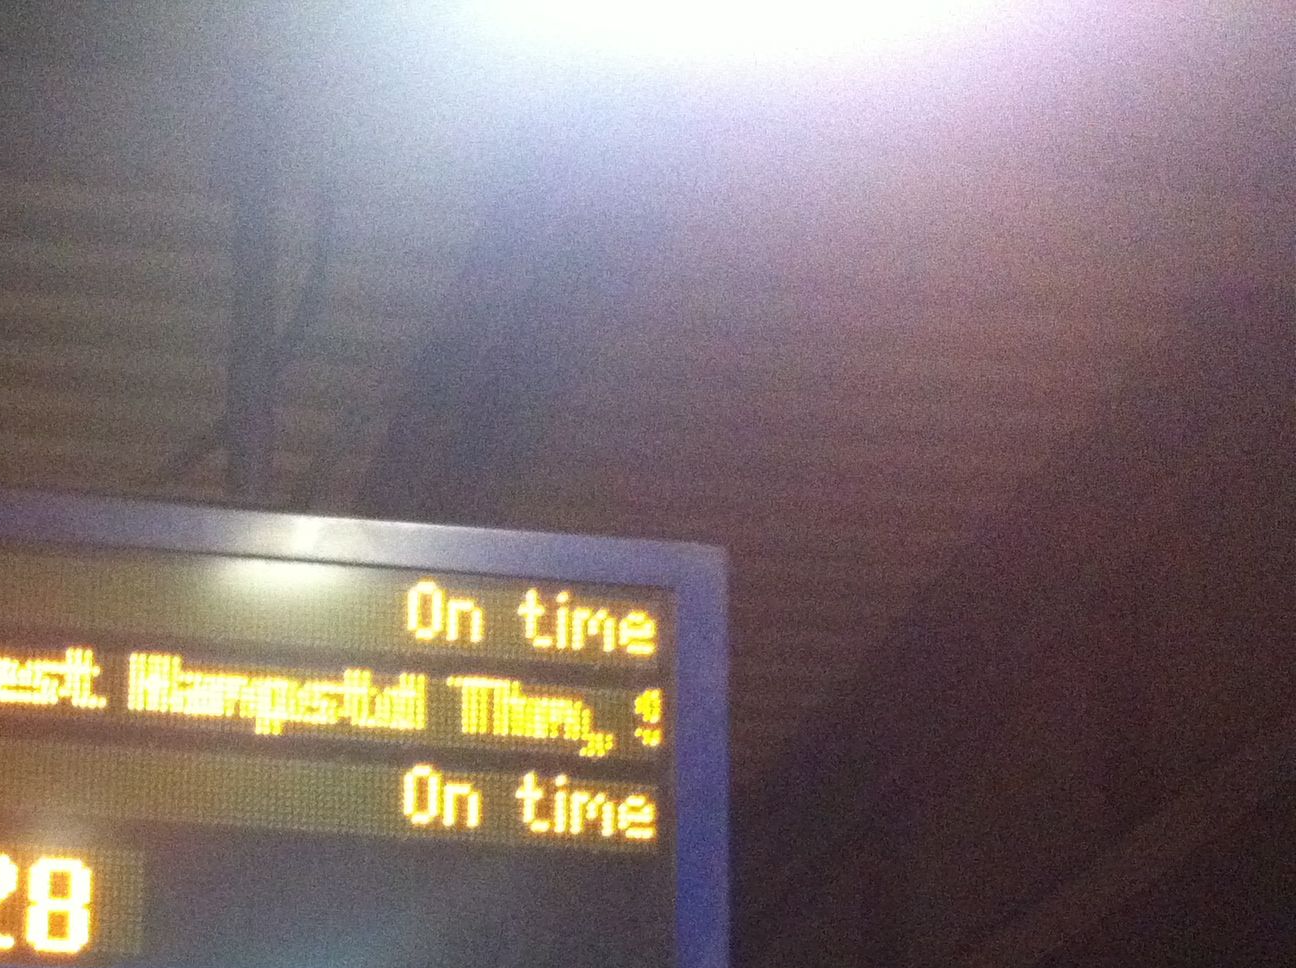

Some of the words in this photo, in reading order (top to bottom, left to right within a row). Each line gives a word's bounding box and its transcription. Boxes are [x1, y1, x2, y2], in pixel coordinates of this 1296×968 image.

[407, 581, 485, 643] On
[517, 588, 657, 655] time
[402, 765, 482, 828] On
[515, 771, 656, 839] time
